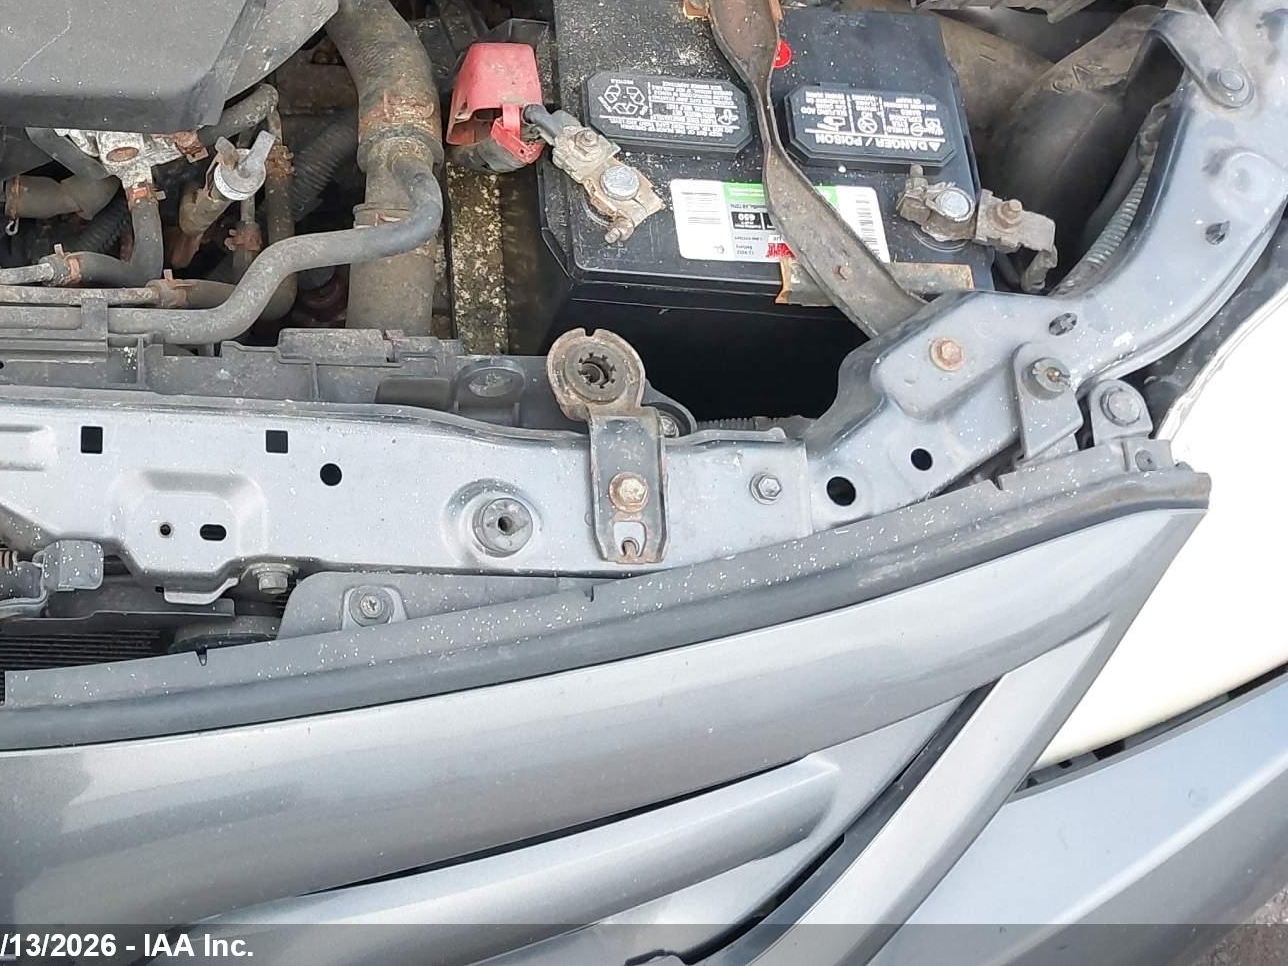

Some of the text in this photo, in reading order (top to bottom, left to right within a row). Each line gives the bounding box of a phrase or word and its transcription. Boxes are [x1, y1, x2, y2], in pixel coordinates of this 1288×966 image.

[815, 134, 862, 146] POISON
[875, 137, 928, 150] DANGER
[738, 213, 756, 221] 650
